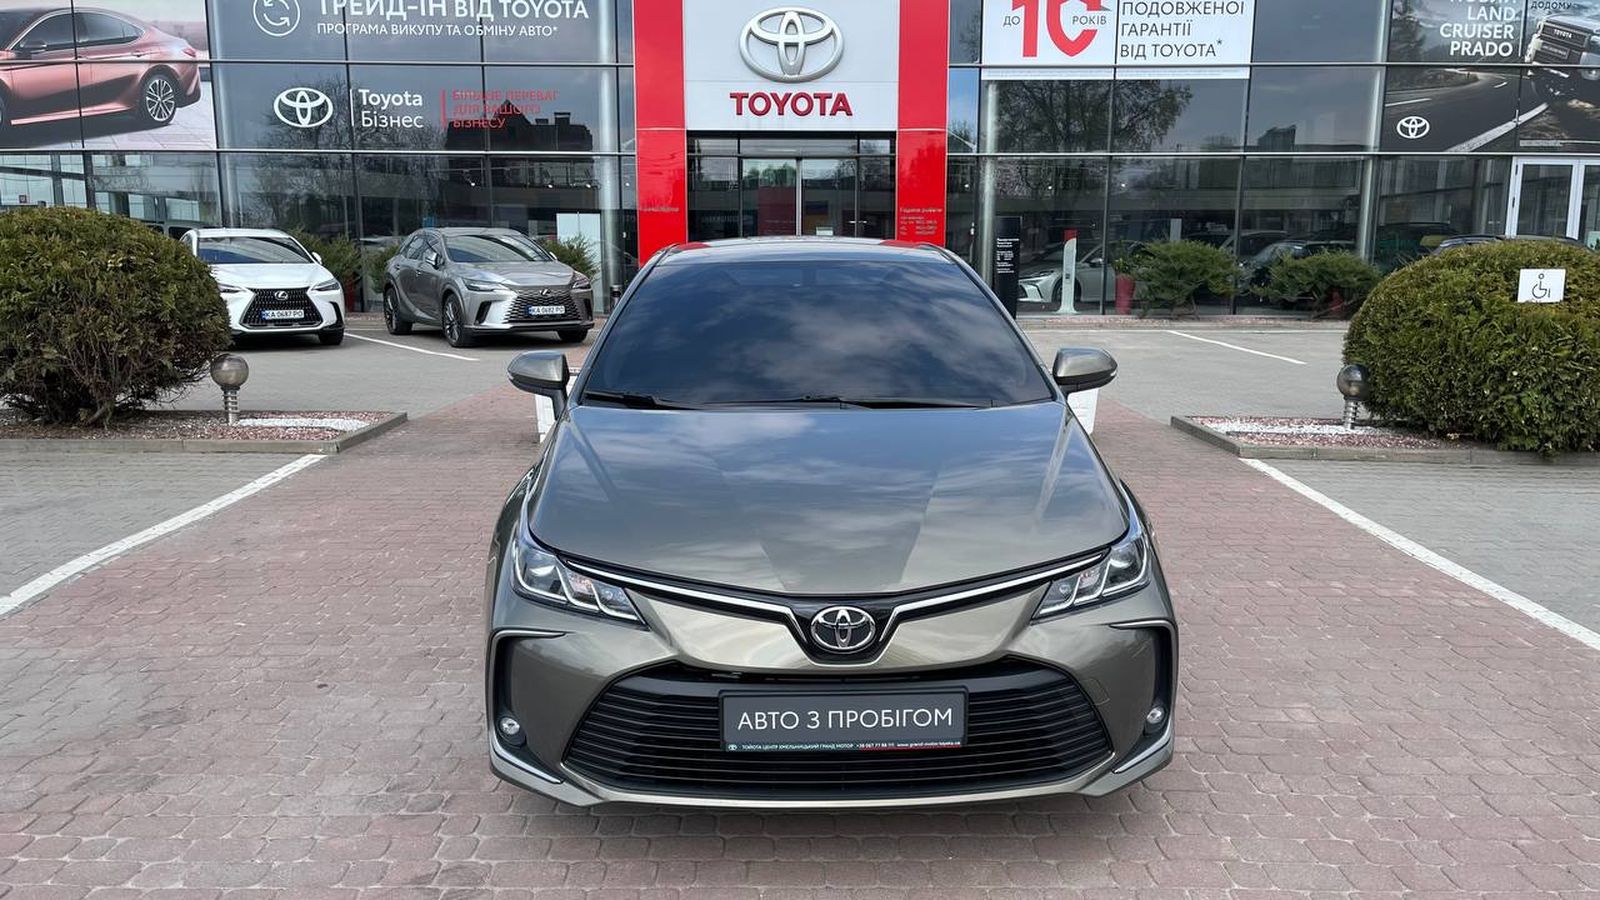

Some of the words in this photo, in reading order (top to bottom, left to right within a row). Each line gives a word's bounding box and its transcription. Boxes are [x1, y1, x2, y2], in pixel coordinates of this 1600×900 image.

[455, 0, 494, 21] ВІД
[499, 0, 589, 18] TOYOTA
[1467, 6, 1516, 21] LAND
[1530, 1, 1573, 11] ДОДОМУ
[1003, 15, 1021, 27] ДО
[1072, 15, 1107, 26] РОКІВ
[1121, 19, 1193, 37] ГАРАНТІЇ
[317, 23, 388, 35] ПРОГРАМА
[391, 24, 443, 36] ВИКУПУ
[446, 25, 461, 36] ТА
[464, 25, 516, 36] ОБМІНУ
[1439, 23, 1515, 39] CRUISER
[1553, 29, 1573, 39] TOYOTA
[1120, 44, 1147, 60] ВІД
[1449, 41, 1514, 57] PRADO
[358, 89, 423, 110] Toyota
[729, 92, 853, 117] TOYOTA
[361, 110, 424, 128] Бізнес
[453, 117, 506, 129] БІЗНЕСУ
[737, 711, 799, 730] АВТО
[807, 710, 820, 729] З
[828, 708, 952, 729] ПРОБІГОМ
